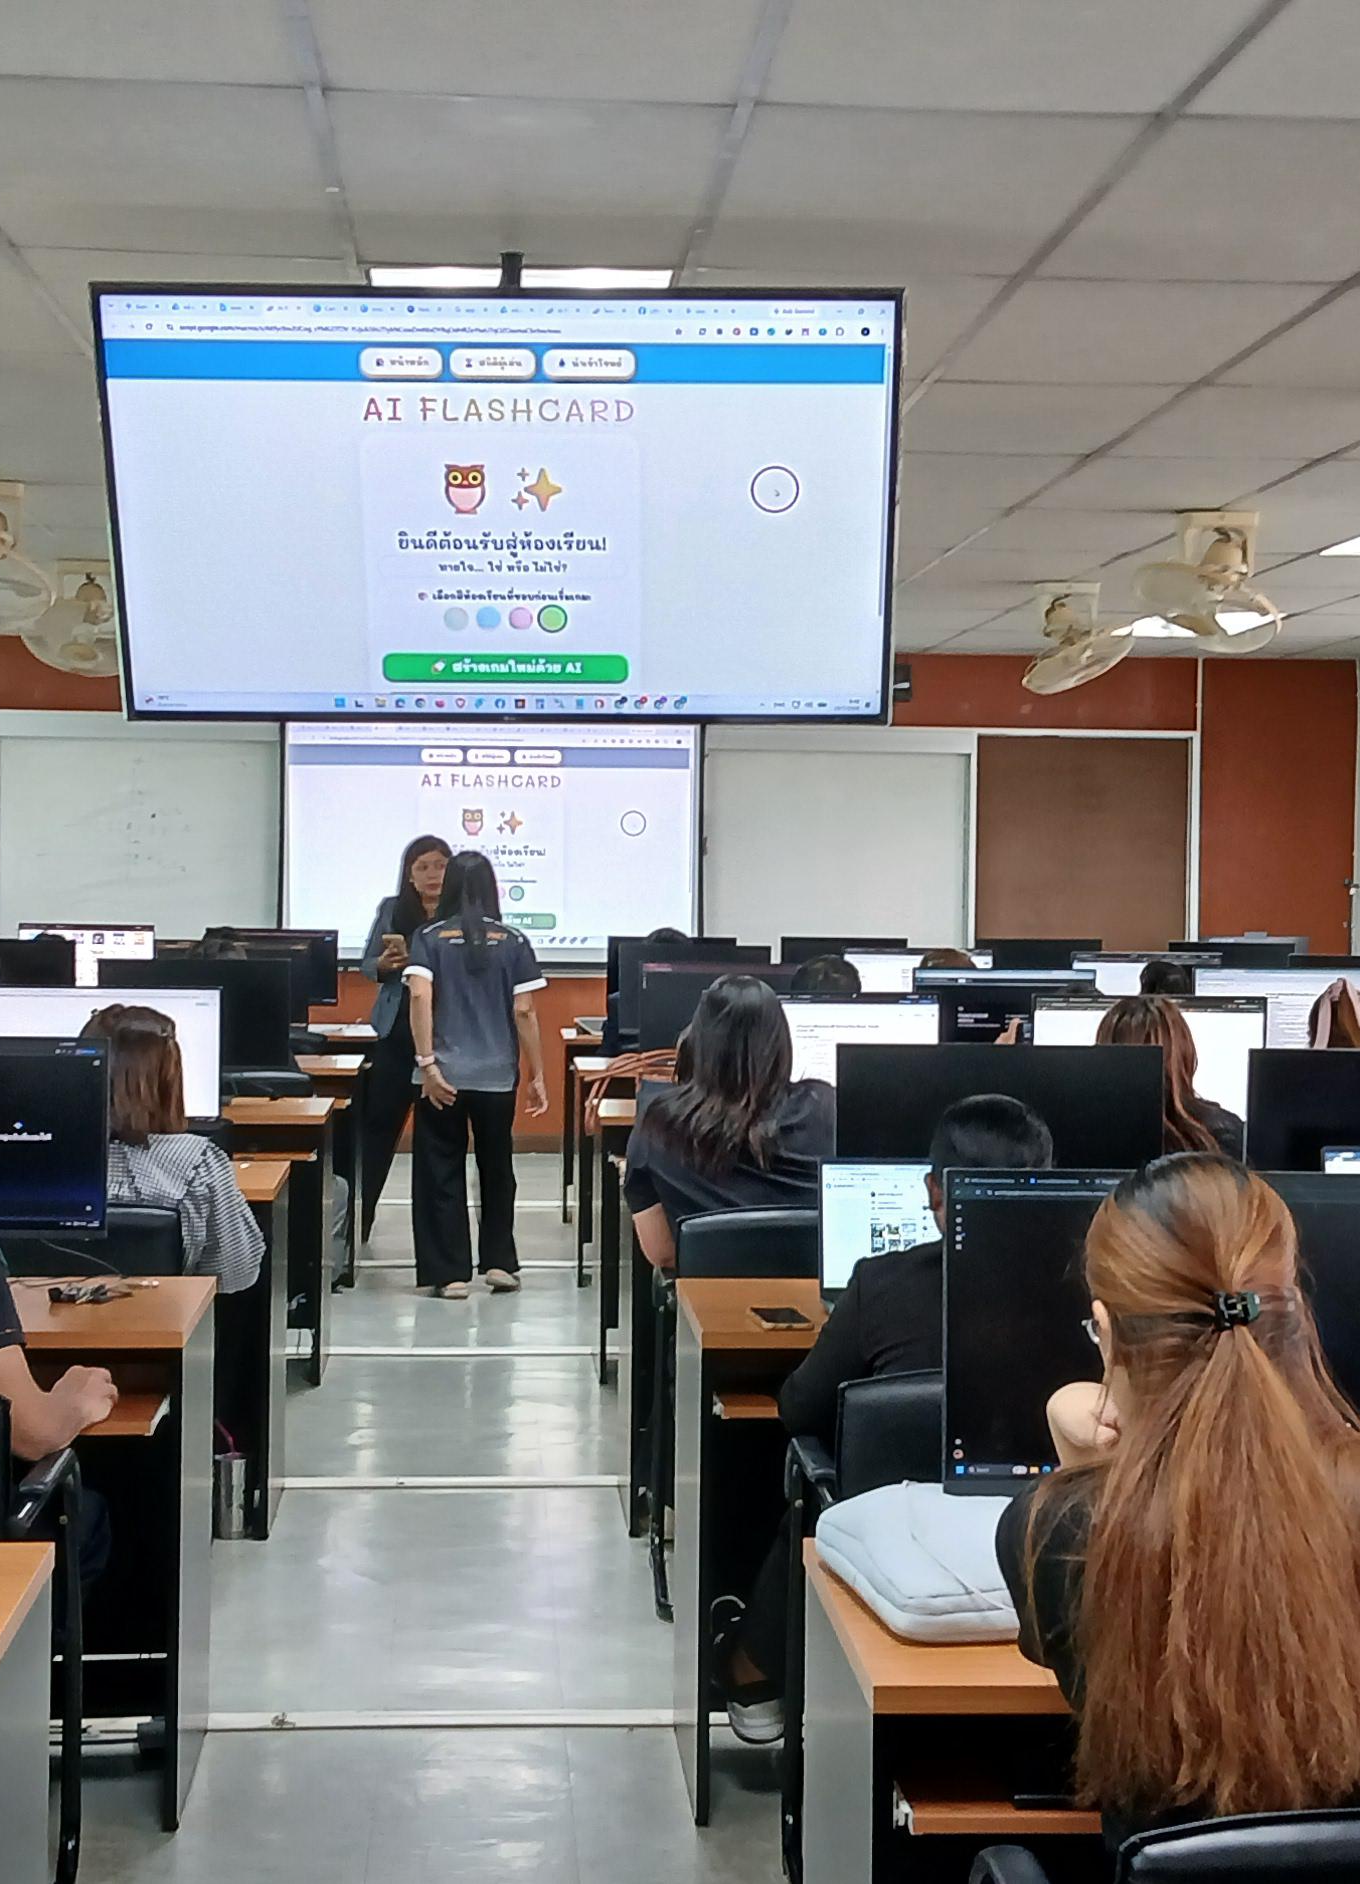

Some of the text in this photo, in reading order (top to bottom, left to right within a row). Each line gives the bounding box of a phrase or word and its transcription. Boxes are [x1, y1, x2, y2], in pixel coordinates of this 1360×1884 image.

[363, 396, 635, 423] AI FLASHCARD
[397, 531, 607, 558] ยินดีต้อนรับสู่ห้องเรียน!
[565, 661, 583, 674] AI
[421, 773, 562, 788] AI FLASHCARD
